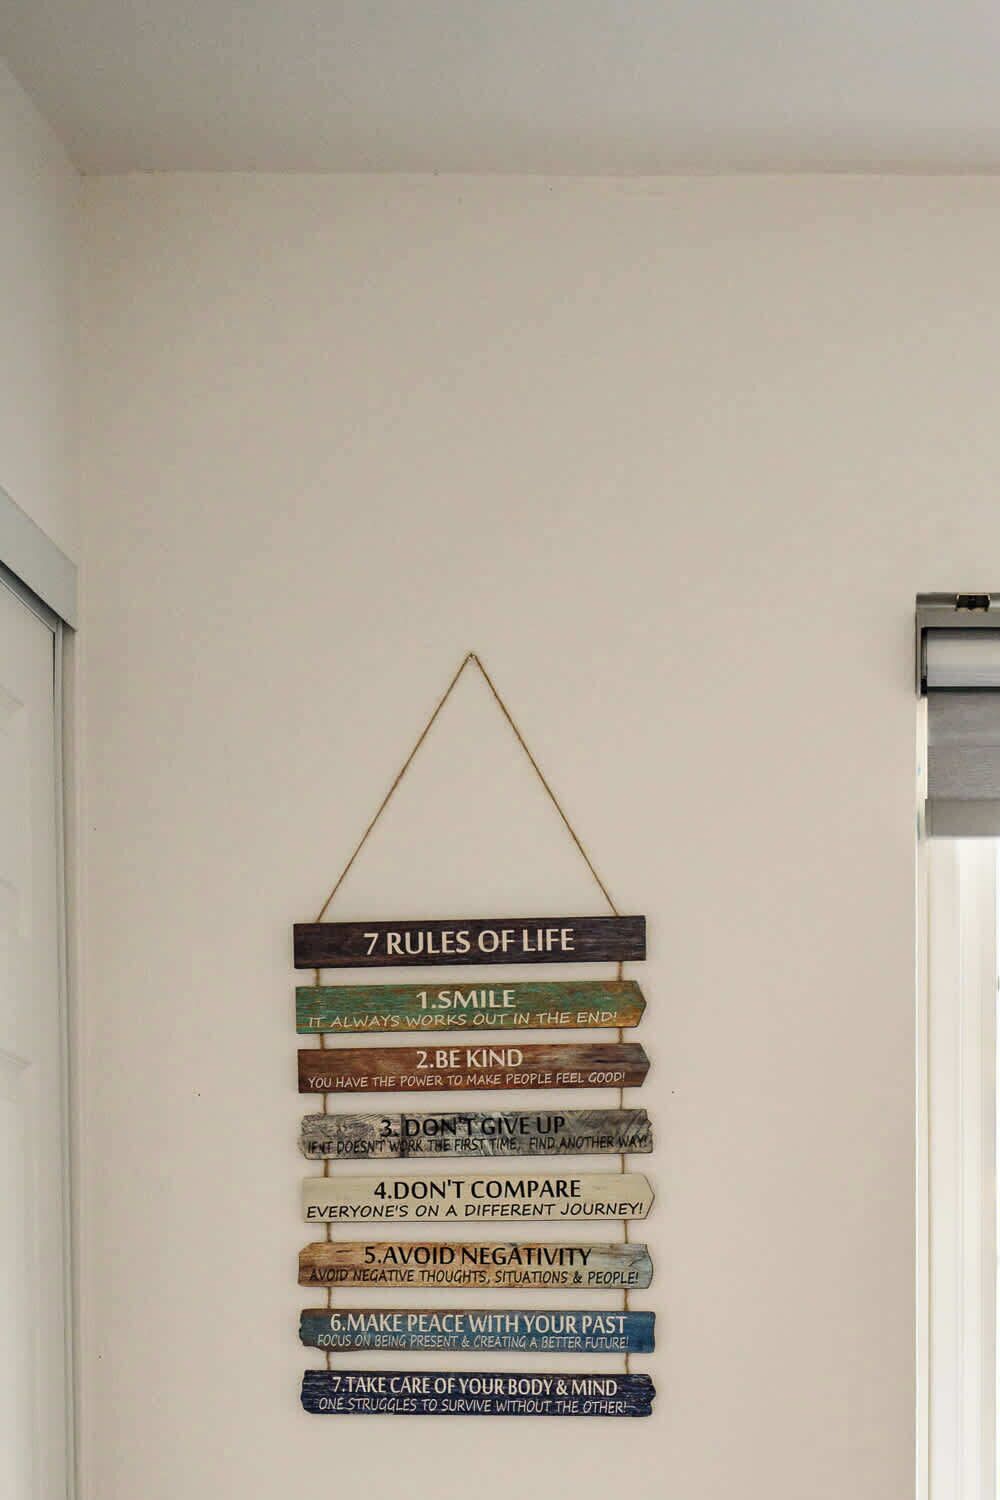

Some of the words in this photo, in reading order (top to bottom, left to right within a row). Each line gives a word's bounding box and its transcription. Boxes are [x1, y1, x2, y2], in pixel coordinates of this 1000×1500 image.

[363, 932, 379, 956] 7
[387, 930, 471, 955] RULES
[478, 929, 515, 953] OF
[522, 928, 575, 952] LIFE
[415, 989, 517, 1010] 1.SMILE
[308, 1016, 326, 1028] IT
[330, 1014, 400, 1028] ALWAYS
[406, 1013, 467, 1027] WORKS
[472, 1013, 508, 1026] OUT
[513, 1012, 530, 1025] IN
[536, 1011, 571, 1024] THE
[576, 1010, 617, 1023] END!
[466, 1048, 523, 1068] KIND
[308, 1077, 332, 1089] YOU
[335, 1076, 369, 1088] HAVE
[372, 1077, 396, 1087] THE
[400, 1075, 444, 1087] POWER
[447, 1074, 463, 1086] TO
[466, 1074, 502, 1086] MAKE
[506, 1073, 552, 1085] PEOPLE
[556, 1072, 585, 1084] FEEL
[588, 1071, 626, 1083] GOOD!
[481, 1116, 530, 1135] GIVE
[536, 1115, 566, 1134] UP
[426, 1138, 450, 1151] THE
[453, 1137, 487, 1151] FIRST
[530, 1136, 555, 1149] FIND
[559, 1135, 615, 1149] ANOTHER
[470, 1179, 582, 1199] COMPARE
[306, 1205, 409, 1219] EVERYONE'S
[415, 1204, 440, 1217] ON
[445, 1204, 458, 1217] A
[463, 1202, 556, 1217] DIFFERENT
[560, 1202, 644, 1215] JOURNEY!
[461, 1247, 592, 1266] NEGATIVITY
[309, 1268, 348, 1282] AVOID
[353, 1268, 415, 1282] NEGATIVE
[420, 1270, 490, 1284] THOUGHTS,
[495, 1270, 569, 1284] SITUATIONS
[572, 1272, 583, 1284] &
[587, 1271, 640, 1285] PEOPLE!
[407, 1314, 465, 1333] PEACE
[468, 1315, 520, 1333] WITH
[523, 1315, 578, 1334] YOUR
[581, 1316, 628, 1334] PAST
[317, 1334, 352, 1347] FOCUS
[354, 1335, 372, 1346] ON
[374, 1334, 406, 1347] BEING
[410, 1335, 458, 1347] PRESENT
[461, 1337, 470, 1347] &
[473, 1335, 526, 1349] CREATING
[529, 1337, 538, 1348] A
[541, 1337, 582, 1349] BETTER
[585, 1336, 630, 1349] FUTURE!
[390, 1377, 431, 1394] CARE
[434, 1378, 456, 1394] OF
[458, 1378, 505, 1395] YOUR
[508, 1379, 553, 1396] BODY
[555, 1380, 569, 1396] &
[571, 1379, 618, 1396] MIND
[318, 1397, 344, 1410] ONE
[349, 1398, 417, 1412] STRUGGLES
[421, 1399, 438, 1412] TO
[441, 1399, 491, 1413] SURVIVE
[495, 1399, 552, 1413] WITHOUT
[555, 1401, 581, 1413] THE
[583, 1400, 627, 1414] OTHER!
